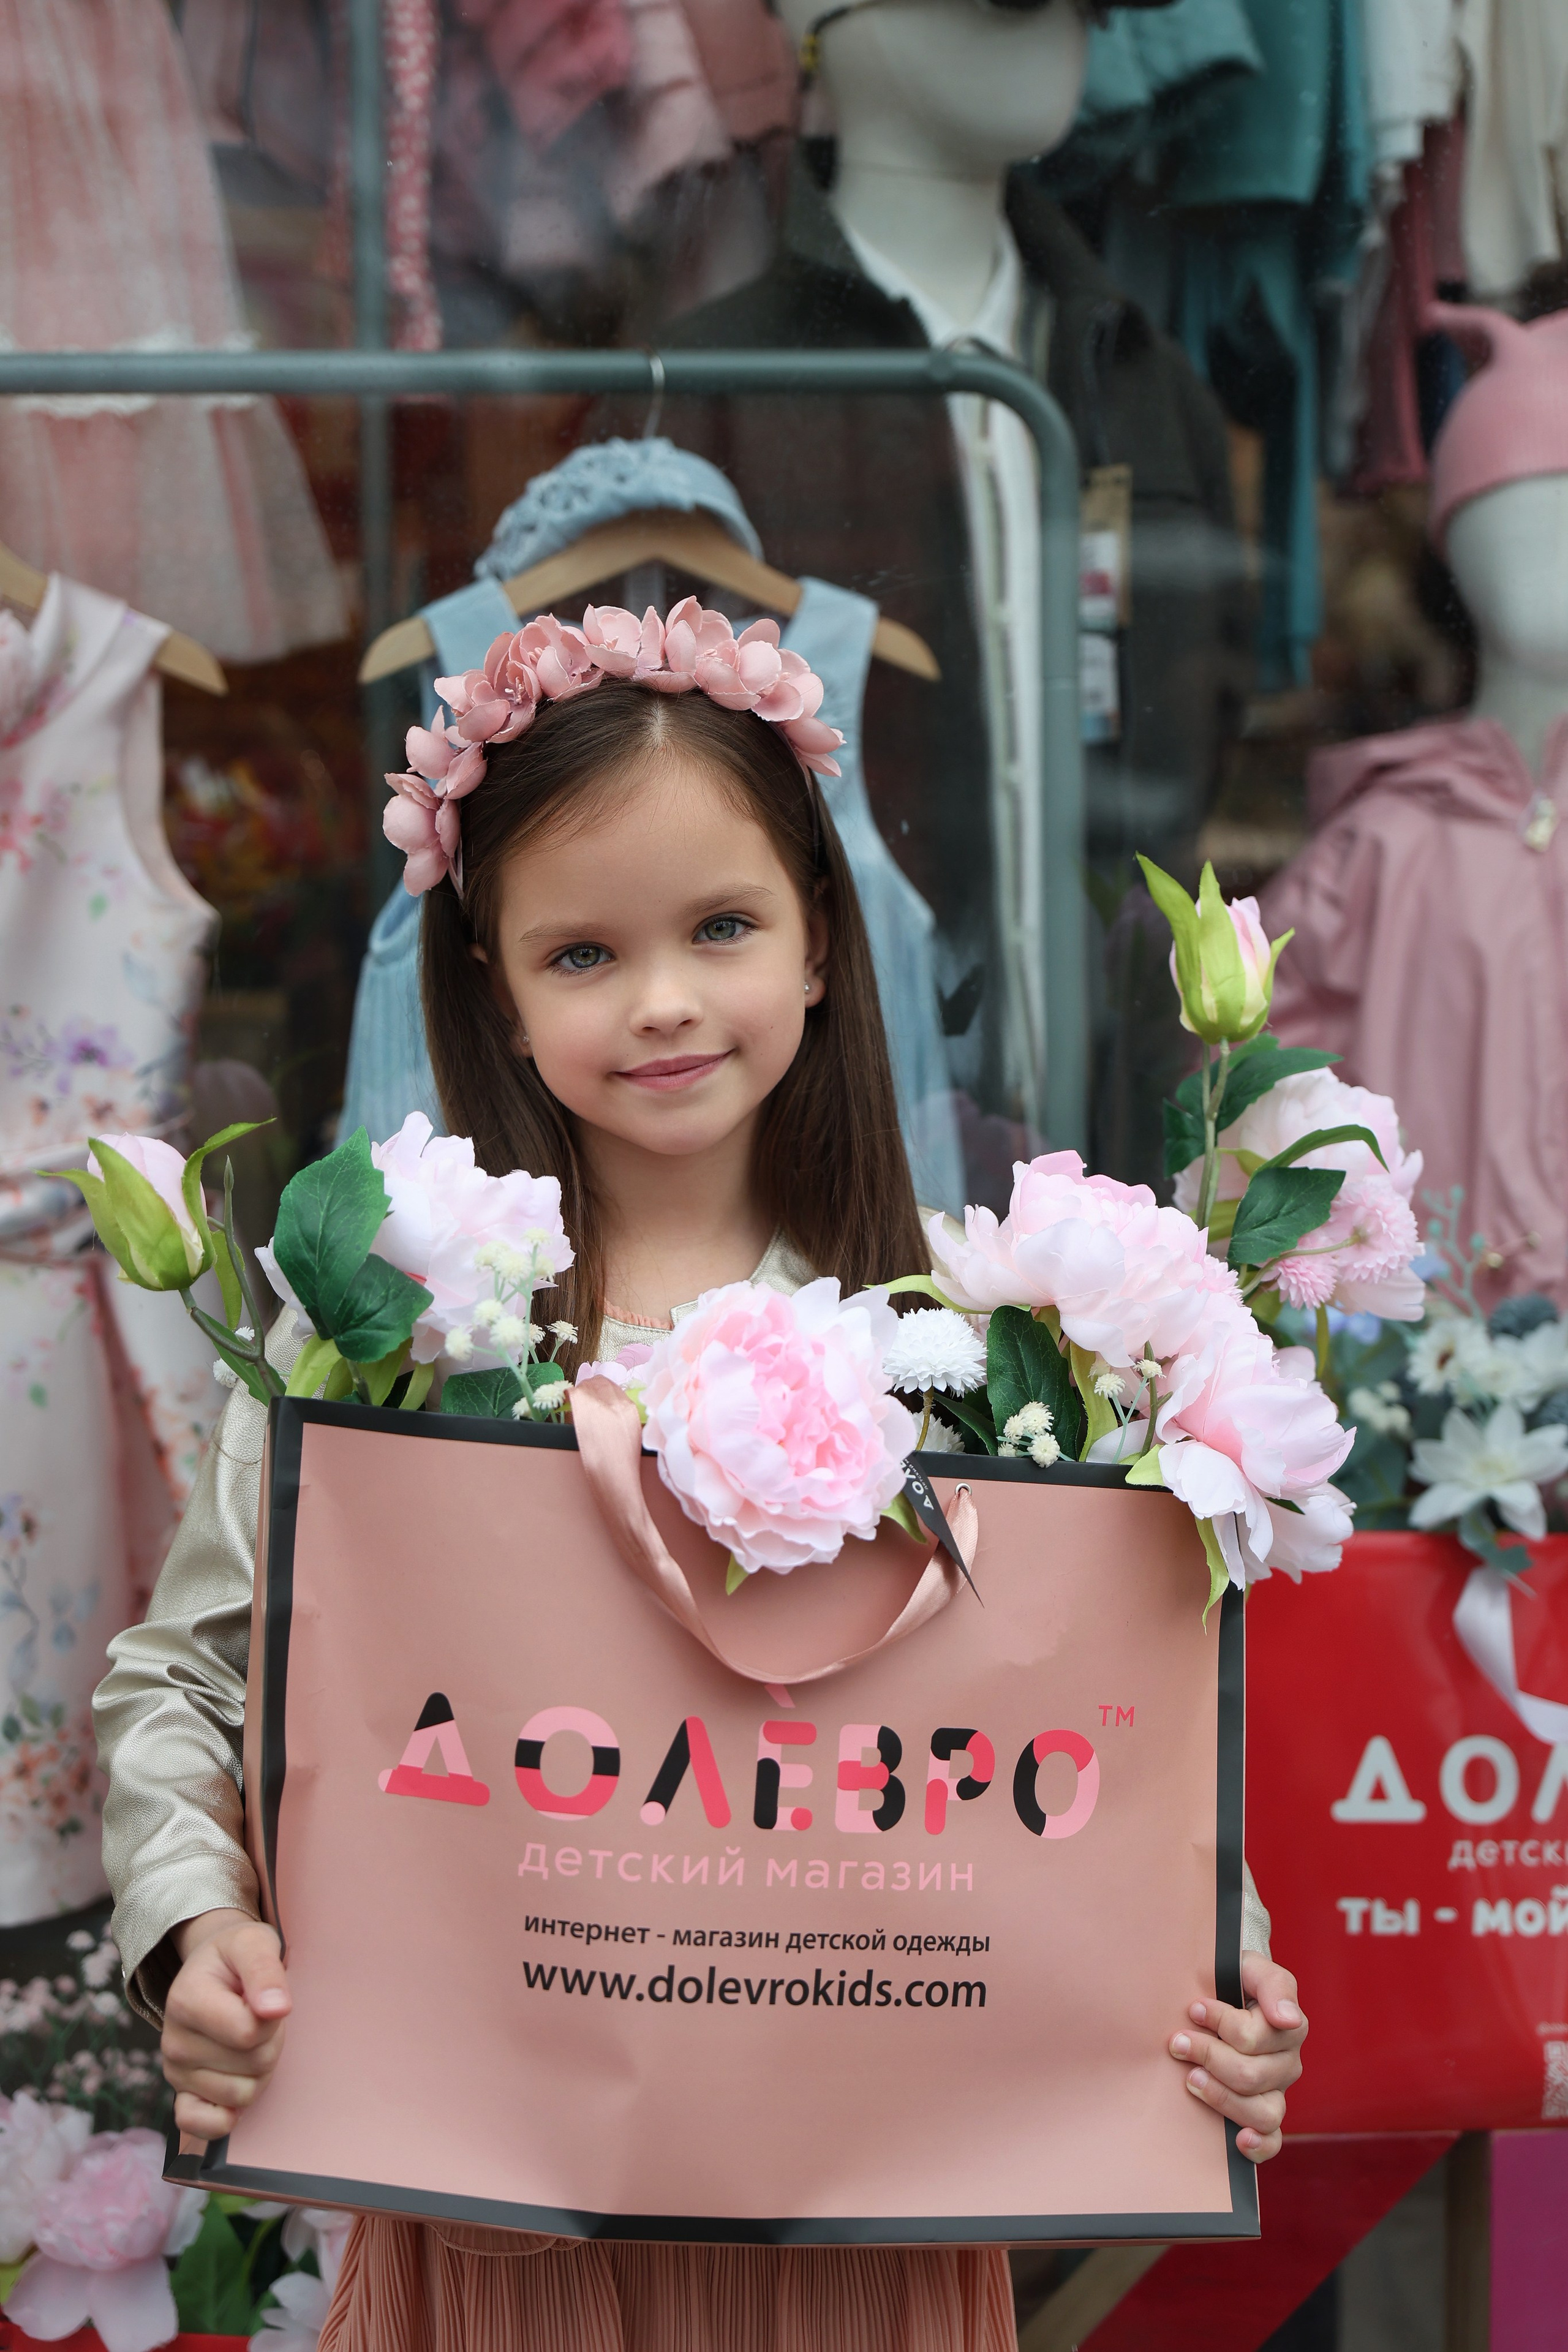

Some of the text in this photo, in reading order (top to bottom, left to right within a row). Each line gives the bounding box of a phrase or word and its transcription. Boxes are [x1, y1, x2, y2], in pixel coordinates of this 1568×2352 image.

[518, 1842, 973, 1891] детский магазин
[1447, 1839, 1568, 1872] детск
[524, 1915, 650, 1945] интернет
[673, 1929, 779, 1948] магазин
[785, 1929, 886, 1953] детской
[893, 1934, 990, 1956] одежды
[522, 1961, 987, 2008] www.dolevrokids.com
